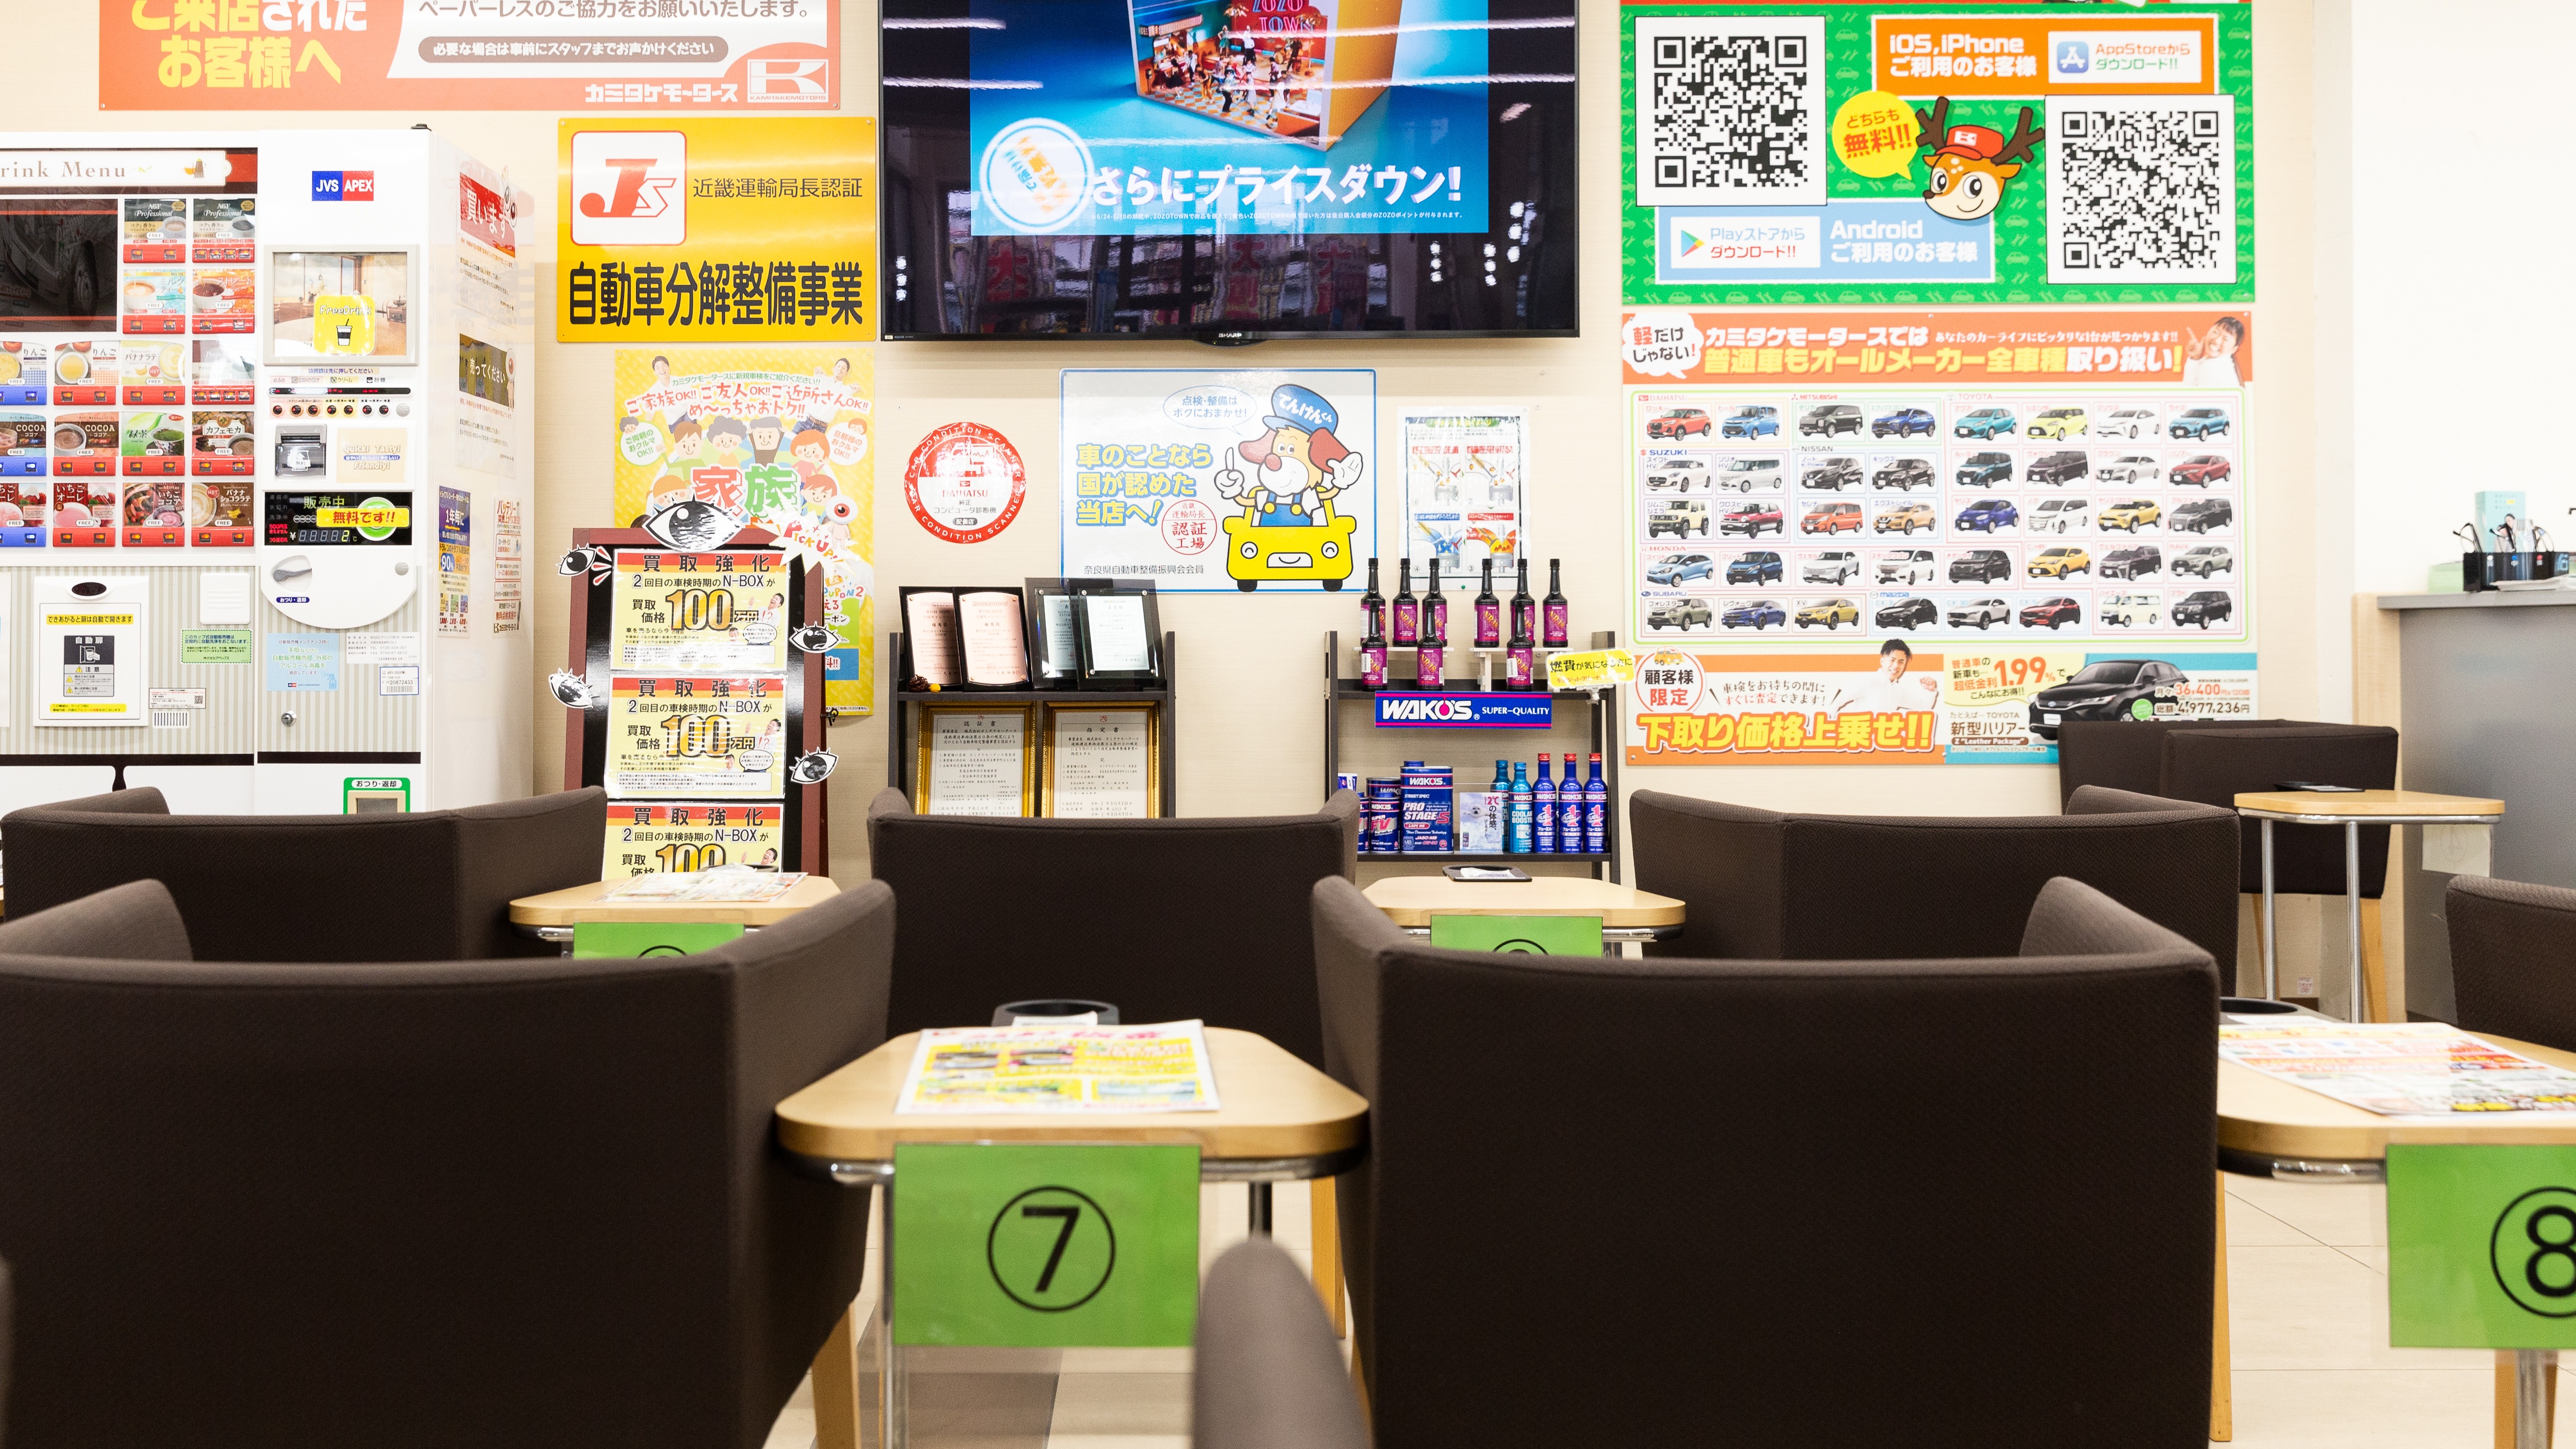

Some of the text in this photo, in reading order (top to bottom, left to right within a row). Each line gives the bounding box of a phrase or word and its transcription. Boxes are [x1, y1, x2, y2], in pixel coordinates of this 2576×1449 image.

[434, 42, 714, 57] 必要な場合は事前にスタッフまでお声かけください
[1889, 34, 2024, 55] iOS,iPhone
[2096, 43, 2190, 57] AppStoreから
[158, 35, 341, 88] お客様へ
[1889, 56, 2037, 78] ご利用のお客様
[2095, 58, 2178, 72] ダウンロード!!
[585, 84, 738, 103] カミタケモータース
[1847, 109, 1900, 129] どちらも
[1844, 124, 1912, 159] 無料!!
[62, 161, 126, 177] Menu
[316, 180, 373, 193] JVS APEX
[693, 178, 863, 199] 近畿運輸局長認証
[134, 210, 173, 219] Professional
[204, 210, 242, 219] Professional
[467, 189, 511, 239] 買います
[1711, 227, 1805, 242] Playストアから
[1830, 220, 1924, 240] Android
[1711, 245, 1795, 258] ダウンロード!!
[1830, 243, 1978, 263] ご利用のお客様
[570, 260, 862, 327] 自動車分解整備事業
[1633, 325, 1684, 345] 軽だけ
[1705, 326, 1929, 348] カミタケモータースでは
[1634, 343, 1696, 363] じゃない!
[1704, 346, 2183, 374] 普通車もオールメーカー全車種取り扱い!
[470, 358, 505, 384] 売ってください
[1173, 408, 1246, 418] ボクにおまかせ!
[1279, 393, 1333, 424] てんけんくん
[129, 430, 148, 438] 緑茶
[626, 429, 654, 444] ご両親の
[834, 430, 863, 445] 旦那様の
[629, 439, 655, 453] おクルマ
[832, 438, 860, 453] おクルマ
[1077, 443, 1213, 468] 車のことなら
[57, 485, 84, 493] いちご
[692, 465, 797, 517] 家族
[1077, 473, 1196, 497] 国が認めた
[303, 495, 345, 509] 販売中
[333, 512, 395, 524] 無料です!!
[922, 516, 982, 540] CONDITION
[987, 491, 1021, 534] SCANNER
[1077, 500, 1164, 526] 当店へ!
[1172, 510, 1206, 518] 運輸局長
[1171, 522, 1208, 537] 認証
[1176, 537, 1204, 549] 工場
[643, 555, 770, 572] 買取強化
[1084, 565, 1204, 575] 奈良県自動車整備振興会会員
[632, 599, 656, 610] 買取
[642, 612, 665, 624] 価格
[1952, 657, 1990, 669] 普通車の
[1644, 670, 1694, 685] 顧客様
[1953, 678, 1997, 691] 超低金利
[639, 680, 766, 697] 買取強化
[1722, 681, 1825, 694] 車検をお待ちの間に
[1970, 689, 2025, 700] こんなにお得!!
[1650, 688, 1689, 707] 限定
[1723, 692, 1826, 706] すぐに査定できます!
[627, 725, 651, 737] 買取
[1639, 713, 1933, 750] 下取り価格上乗せ!!
[1951, 722, 2025, 735] 新型ハリアー
[636, 739, 660, 750] 価格
[633, 807, 764, 826] 買取強化
[622, 854, 646, 865] 買取
